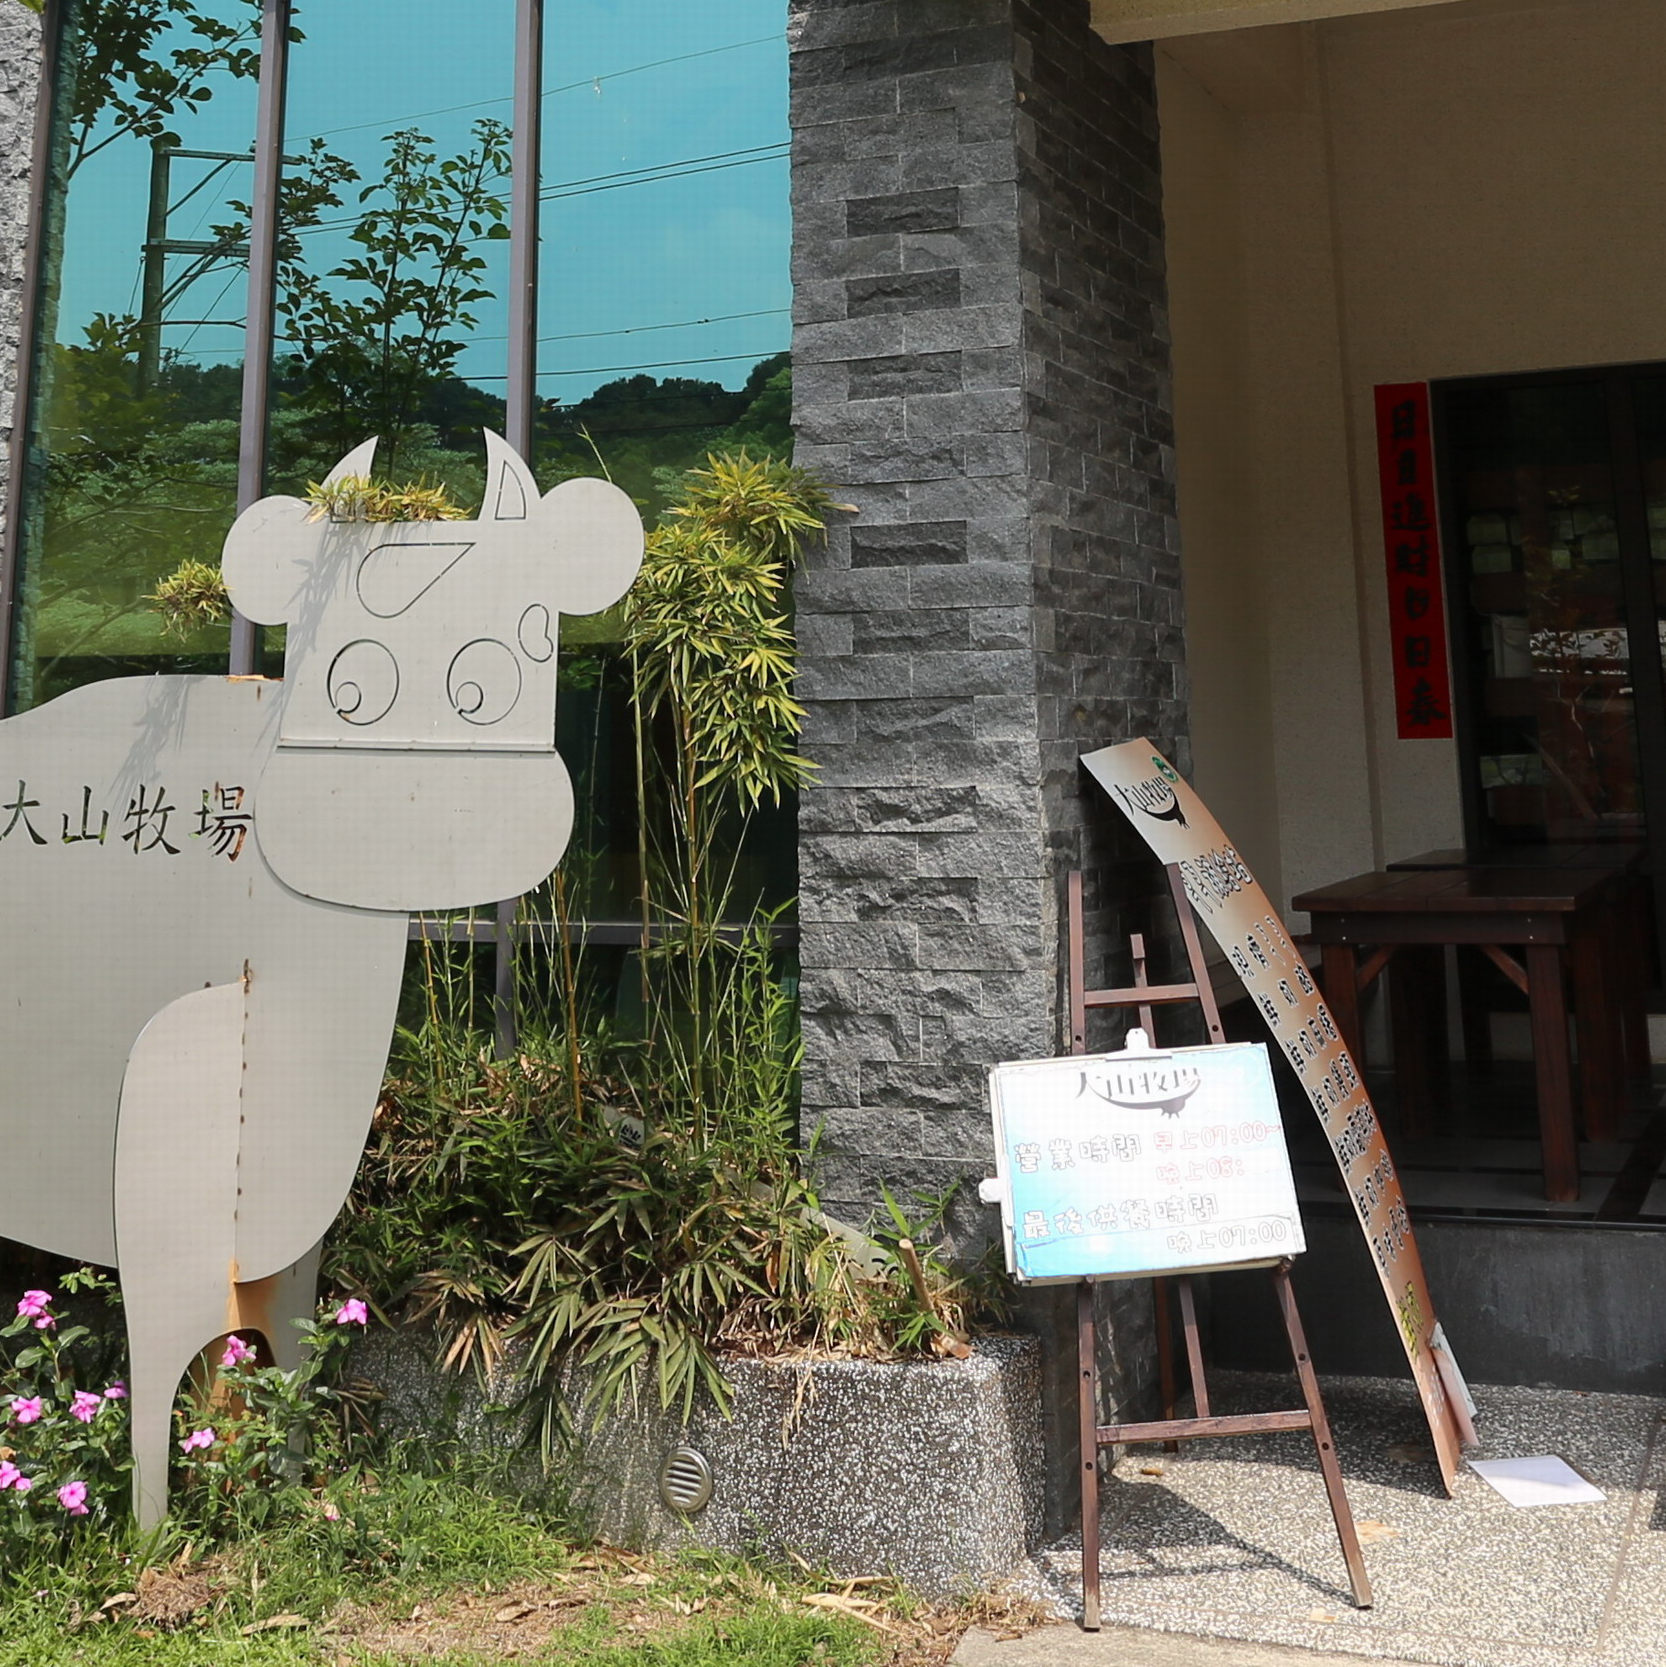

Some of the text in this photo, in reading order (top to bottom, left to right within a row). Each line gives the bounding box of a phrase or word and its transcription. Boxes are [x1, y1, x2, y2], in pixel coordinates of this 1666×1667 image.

[1013, 1133, 1143, 1174] 營業時間
[1022, 1192, 1220, 1240] 最後供餐時間
[1166, 1220, 1288, 1255] 晚上07:00
